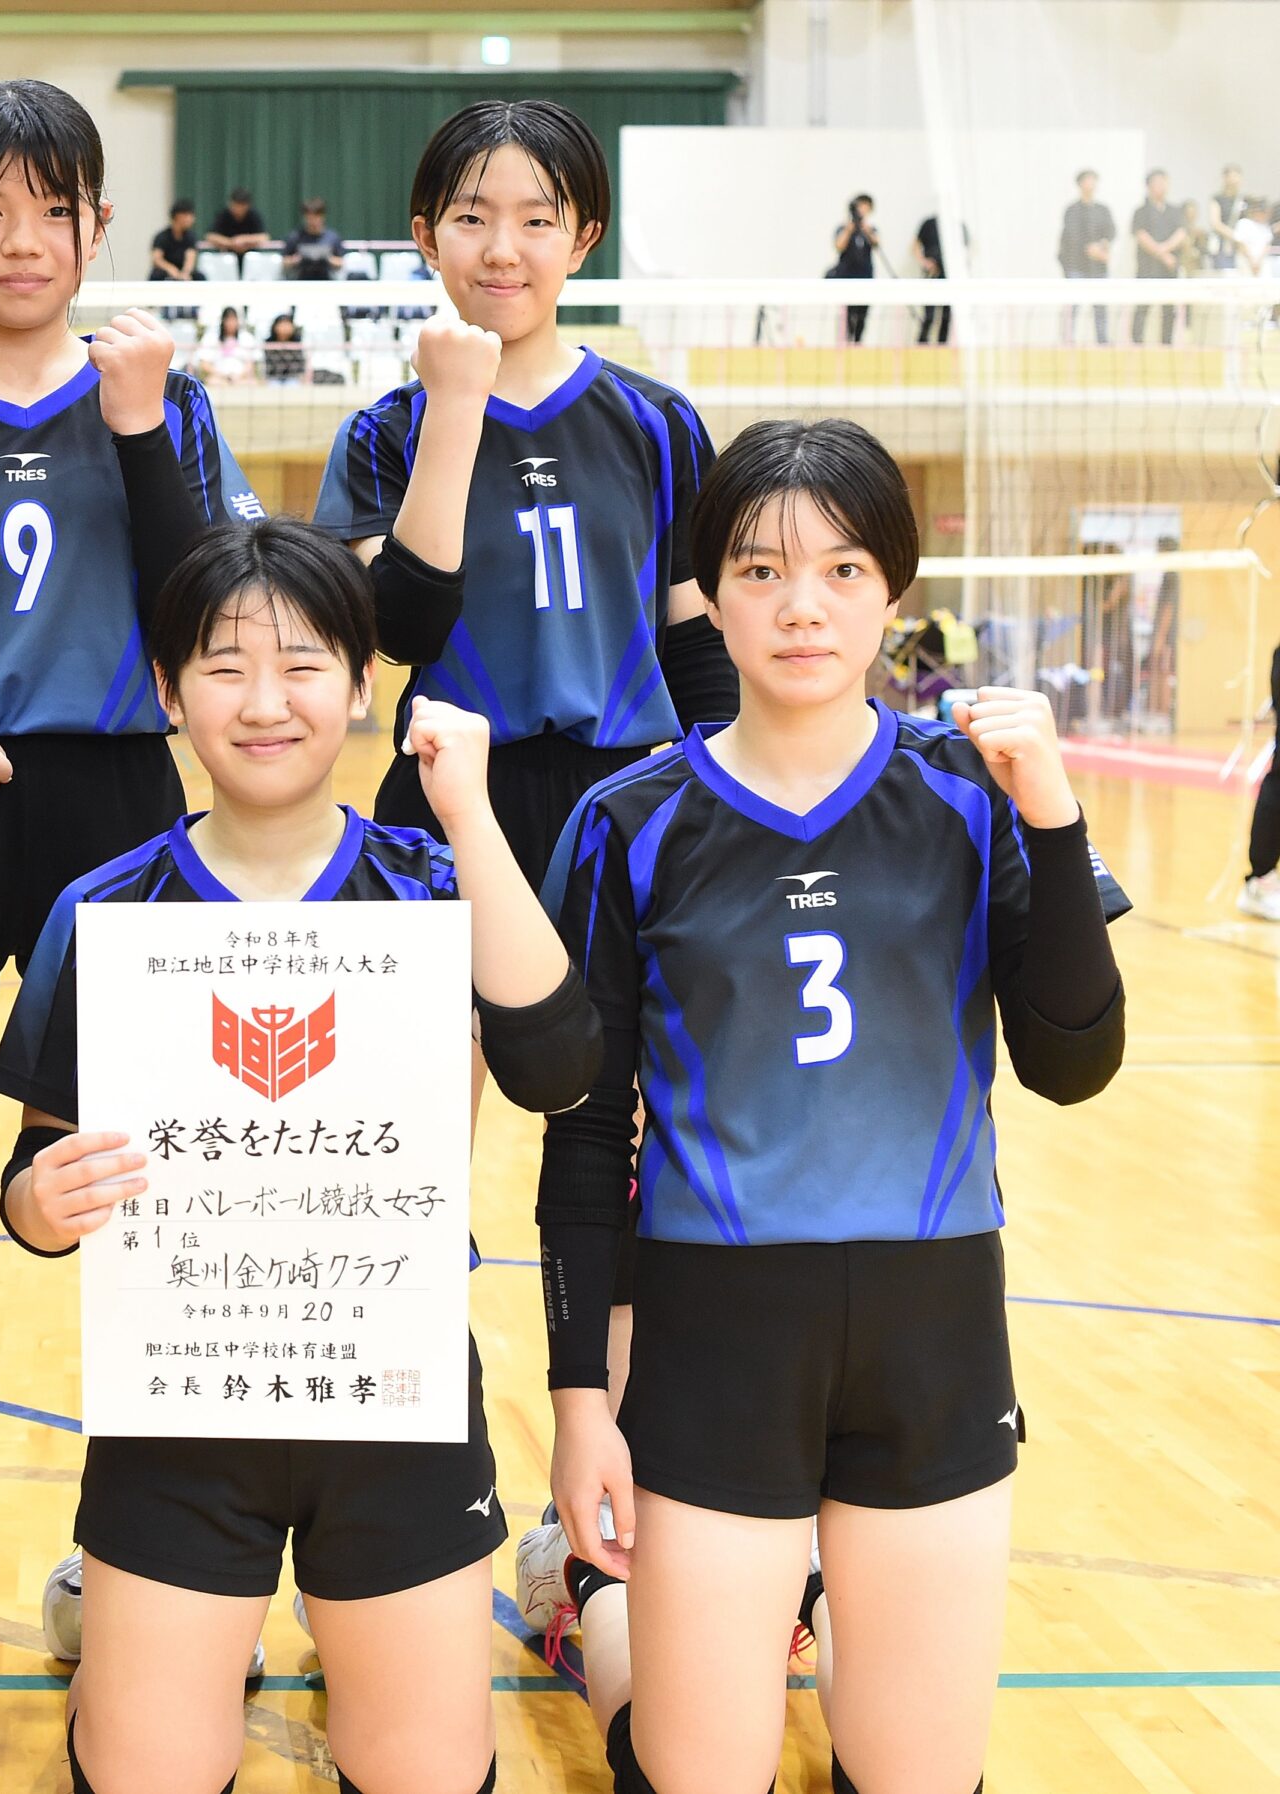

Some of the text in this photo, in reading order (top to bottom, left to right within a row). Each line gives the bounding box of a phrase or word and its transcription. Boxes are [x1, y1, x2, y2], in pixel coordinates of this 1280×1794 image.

[5, 468, 47, 482] TRES
[521, 472, 558, 488] TRES
[1, 500, 55, 614] 9
[516, 504, 585, 611] 11
[785, 890, 838, 910] TRES
[224, 929, 321, 949] 令和8年度
[146, 953, 400, 976] 胆江地区中学校新人大会
[785, 932, 855, 1067] 3
[147, 1116, 401, 1162] 栄誉をたたえる
[120, 1183, 447, 1218] 種目 バレーボール競技女子
[122, 1225, 201, 1251] 第1位
[145, 1341, 358, 1361] 胆江地区中学校体育連盟
[148, 1373, 377, 1405] 会長 鈴木雅孝
